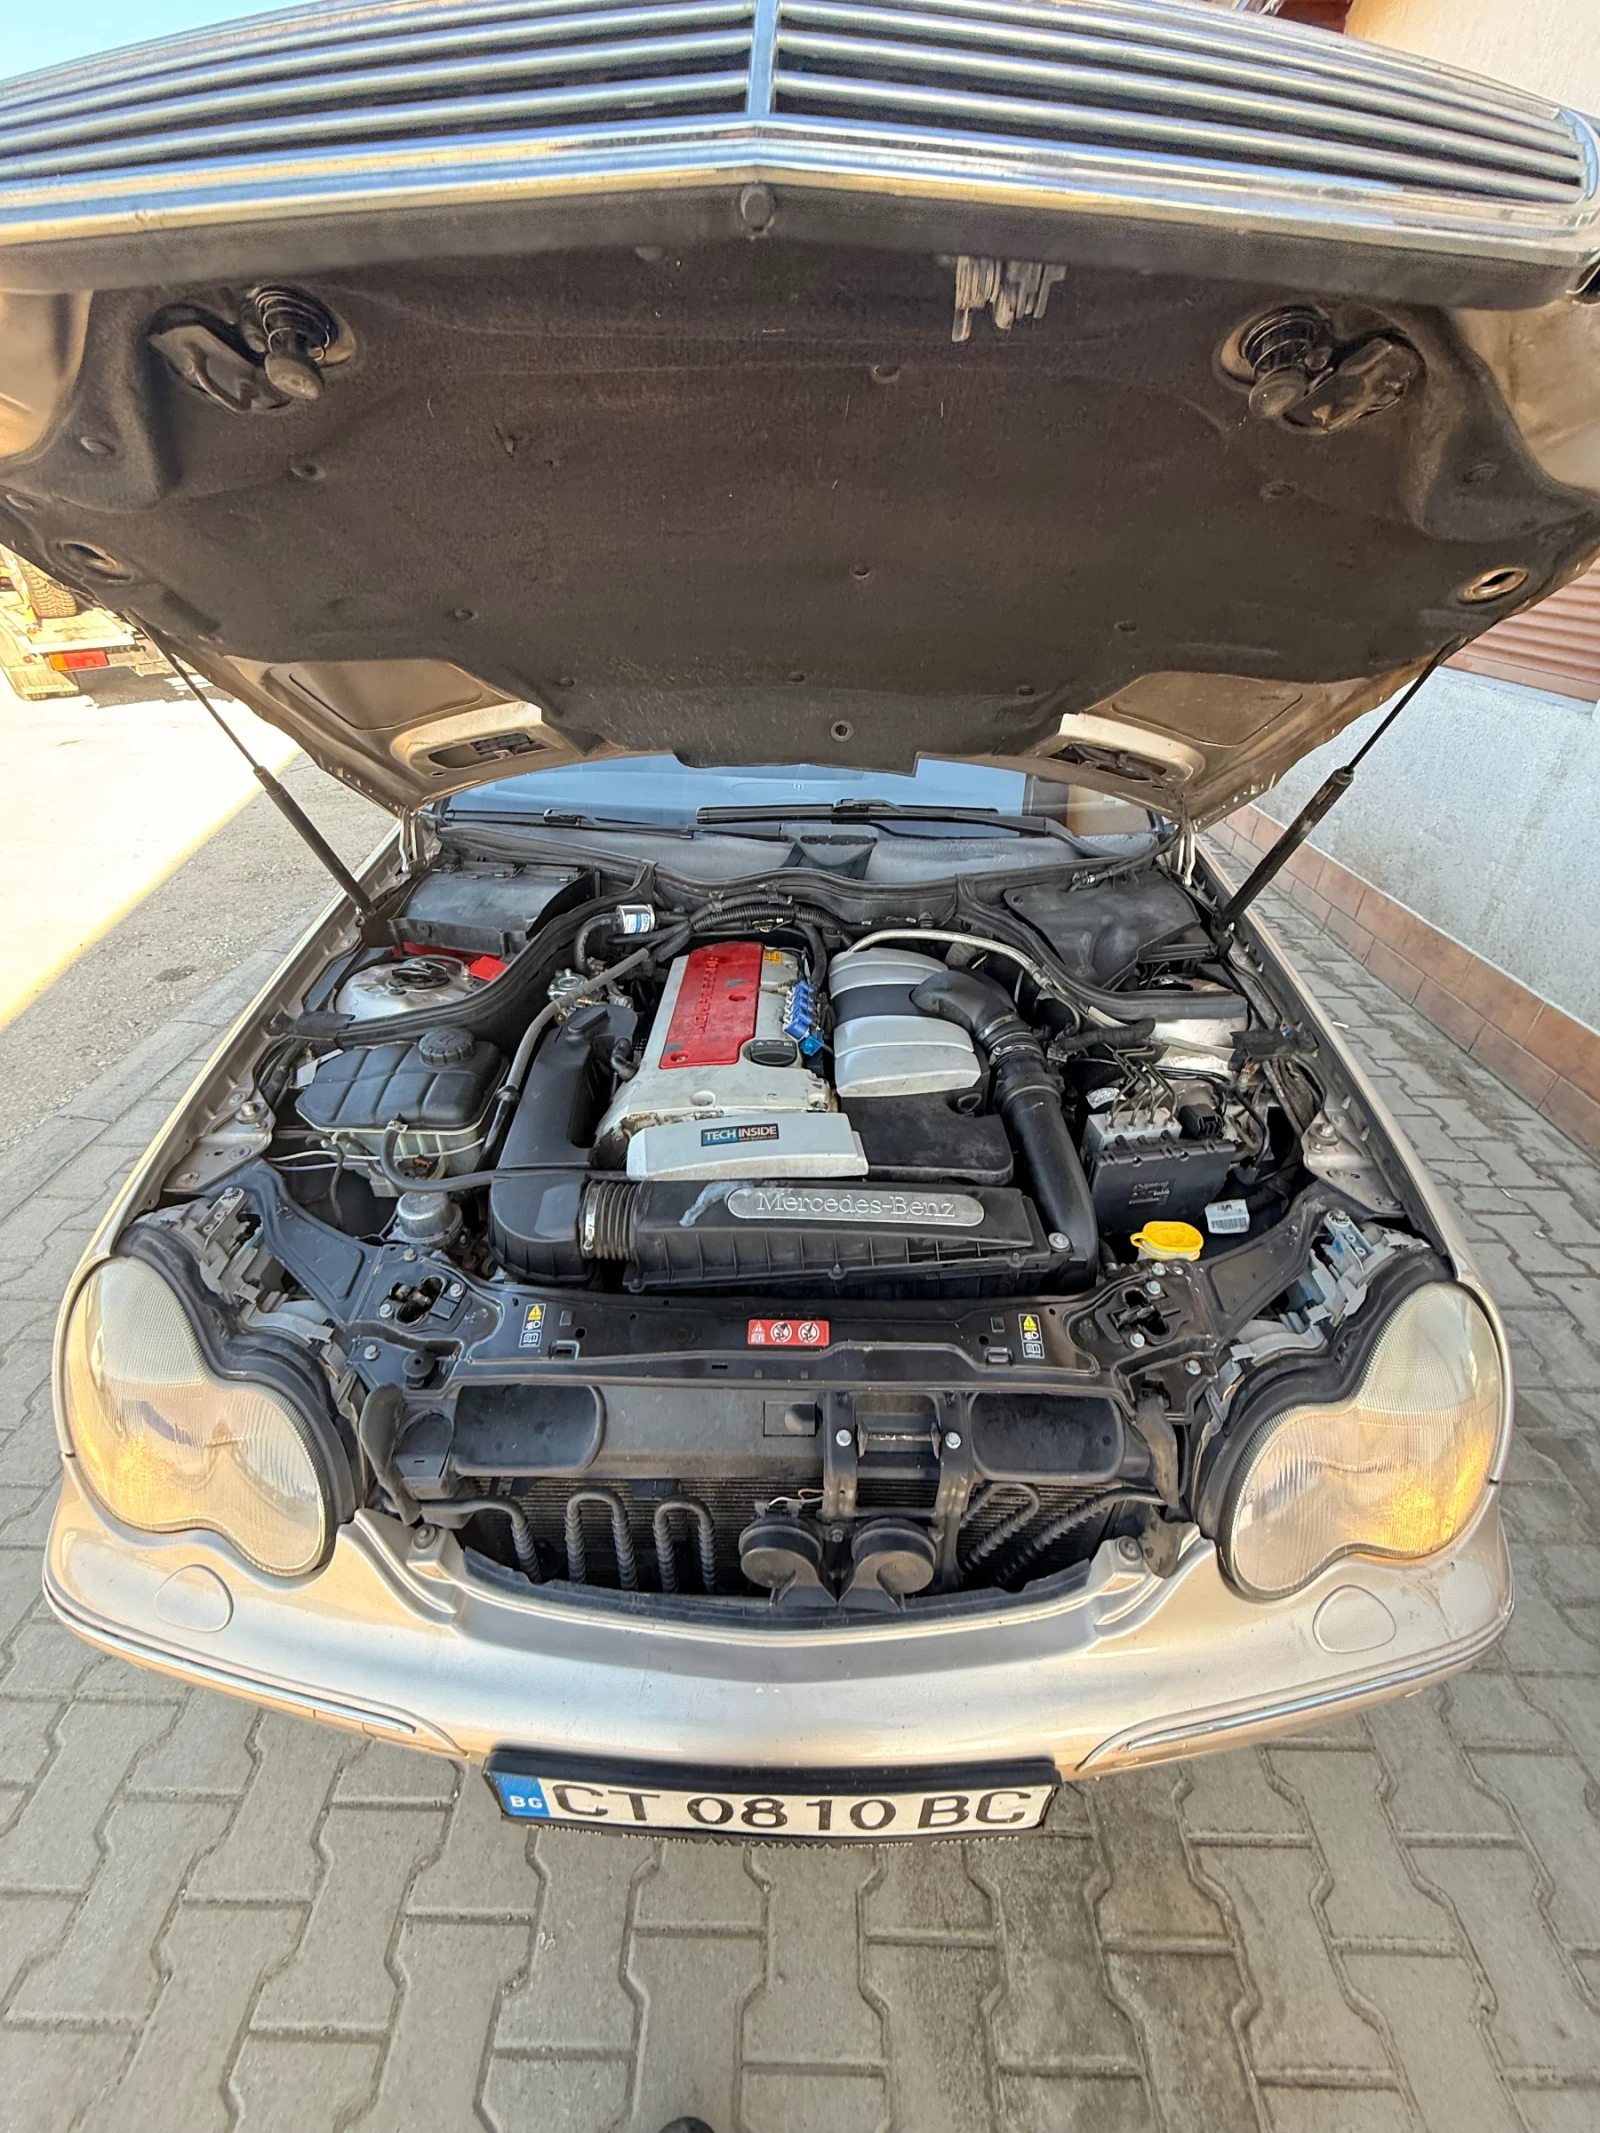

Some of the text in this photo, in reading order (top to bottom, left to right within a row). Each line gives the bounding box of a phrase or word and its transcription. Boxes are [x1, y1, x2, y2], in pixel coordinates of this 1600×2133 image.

[704, 1129, 736, 1141] TECH
[738, 1126, 777, 1137] INSIDE
[757, 1192, 955, 1217] Mercedes-Benz
[509, 1794, 543, 1809] BG
[552, 1784, 1032, 1831] CT 0810 BC
